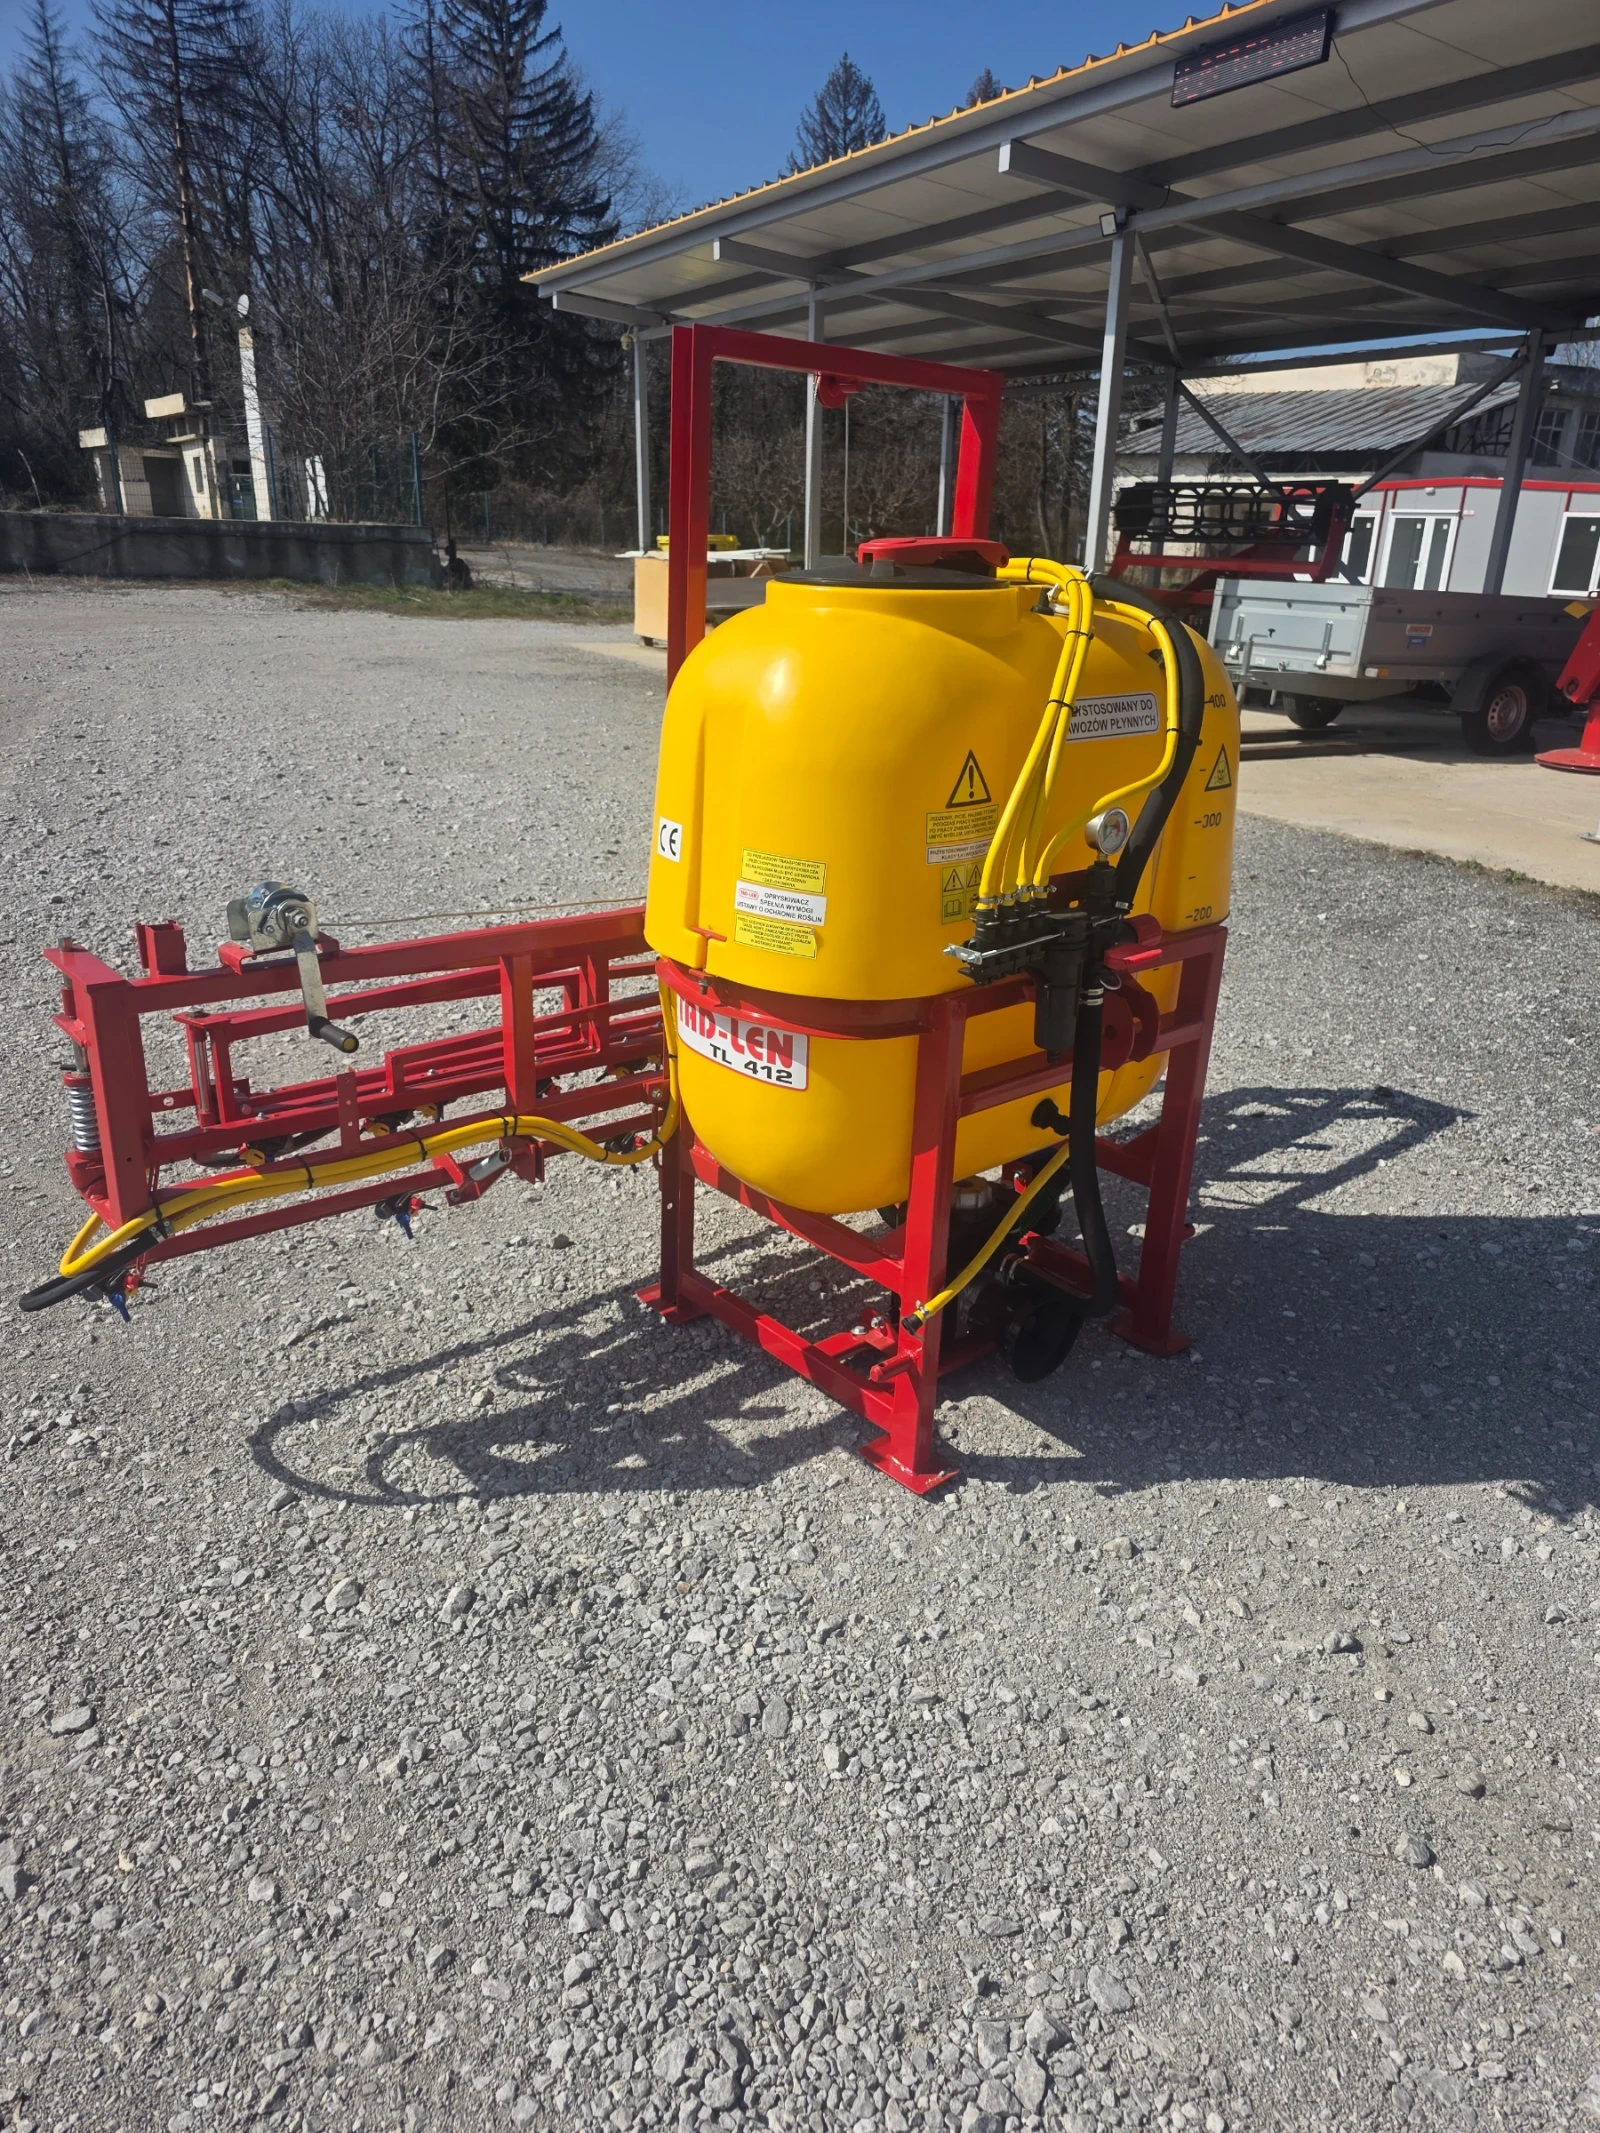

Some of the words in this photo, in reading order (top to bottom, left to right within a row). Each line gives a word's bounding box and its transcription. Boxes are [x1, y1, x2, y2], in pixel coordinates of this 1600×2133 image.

[1140, 699, 1152, 710] DO
[1110, 715, 1156, 730] PŁYNNYCH
[1202, 812, 1222, 828] 300
[760, 898, 784, 910] SPEŁNIA
[786, 904, 814, 914] WYMOGI
[764, 892, 810, 906] OPRYSKIWACZ
[764, 907, 796, 919] OCHRONIE
[797, 912, 822, 922] ROŚLIN
[1194, 905, 1212, 922] 200
[710, 1042, 732, 1065] TL
[744, 1060, 793, 1085] 412
